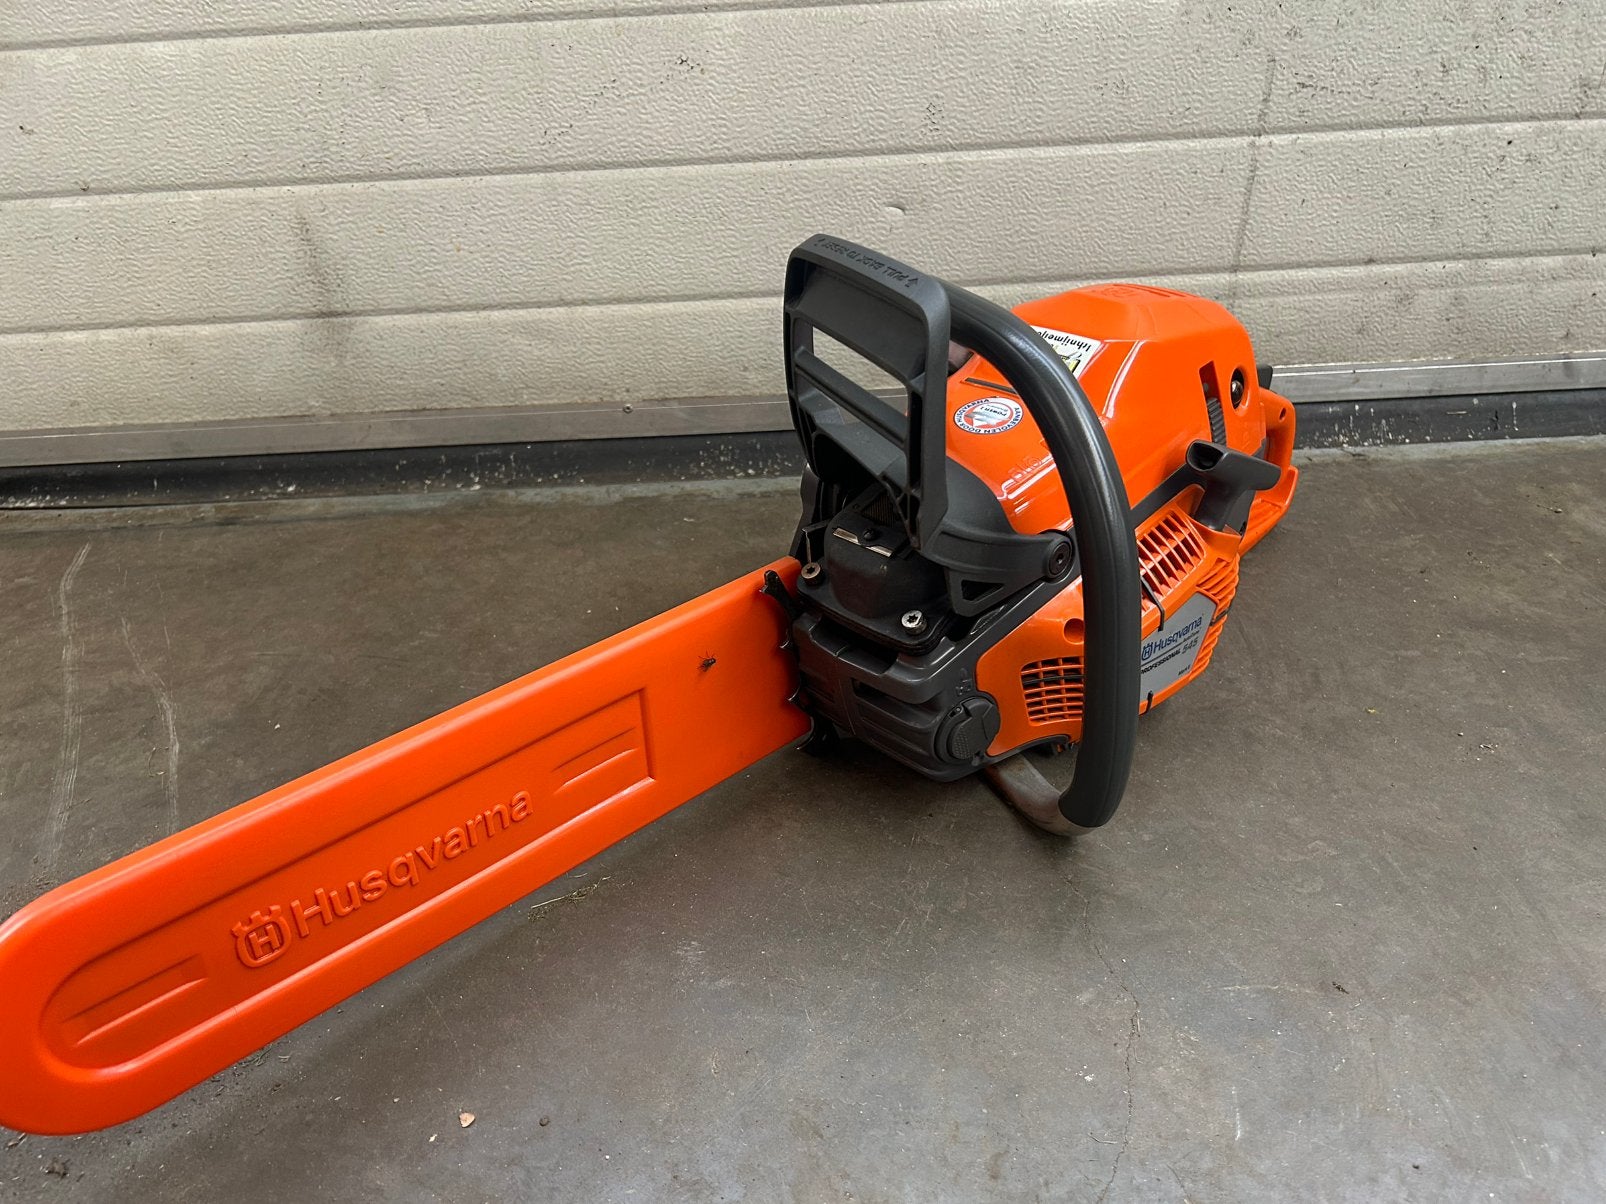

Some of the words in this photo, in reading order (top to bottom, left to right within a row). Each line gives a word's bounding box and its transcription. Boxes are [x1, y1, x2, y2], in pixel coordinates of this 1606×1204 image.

[859, 255, 885, 270] BACK
[882, 266, 909, 281] PULL
[1153, 616, 1202, 653] Husqvarna
[290, 789, 534, 938] Husqvarna
